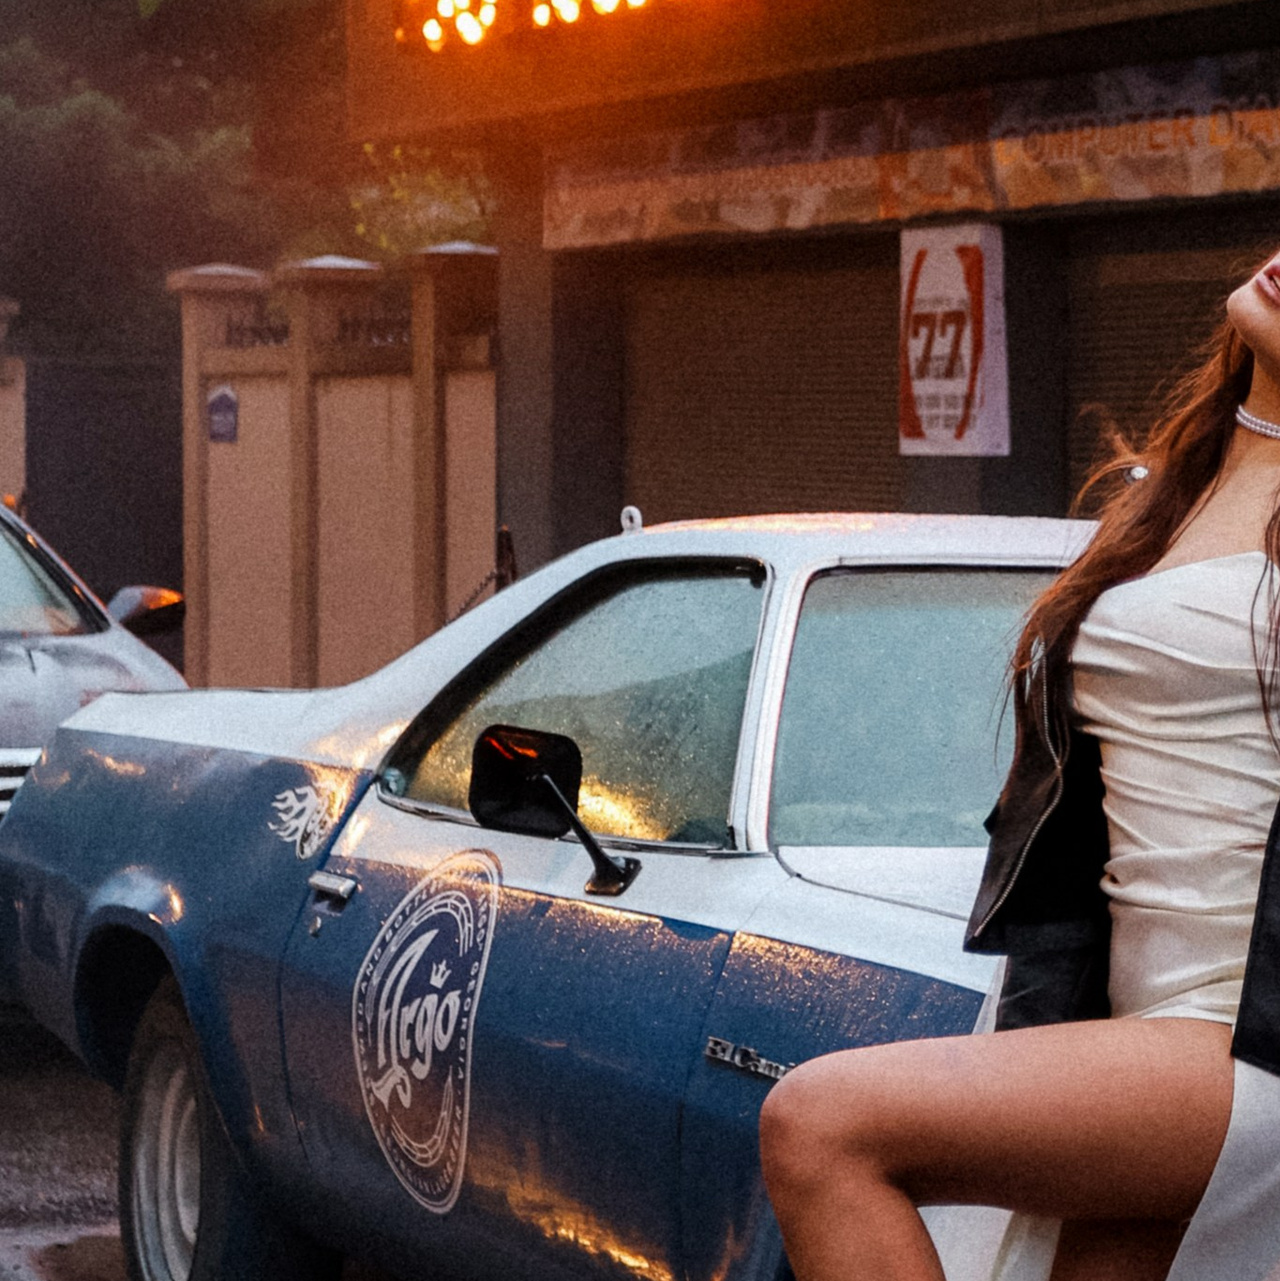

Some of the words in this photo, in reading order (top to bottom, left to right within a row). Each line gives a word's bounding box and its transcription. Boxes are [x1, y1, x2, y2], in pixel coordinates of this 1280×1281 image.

[996, 107, 1197, 166] COMPUTER
[911, 309, 968, 380] 77
[371, 929, 462, 1111] Argo
